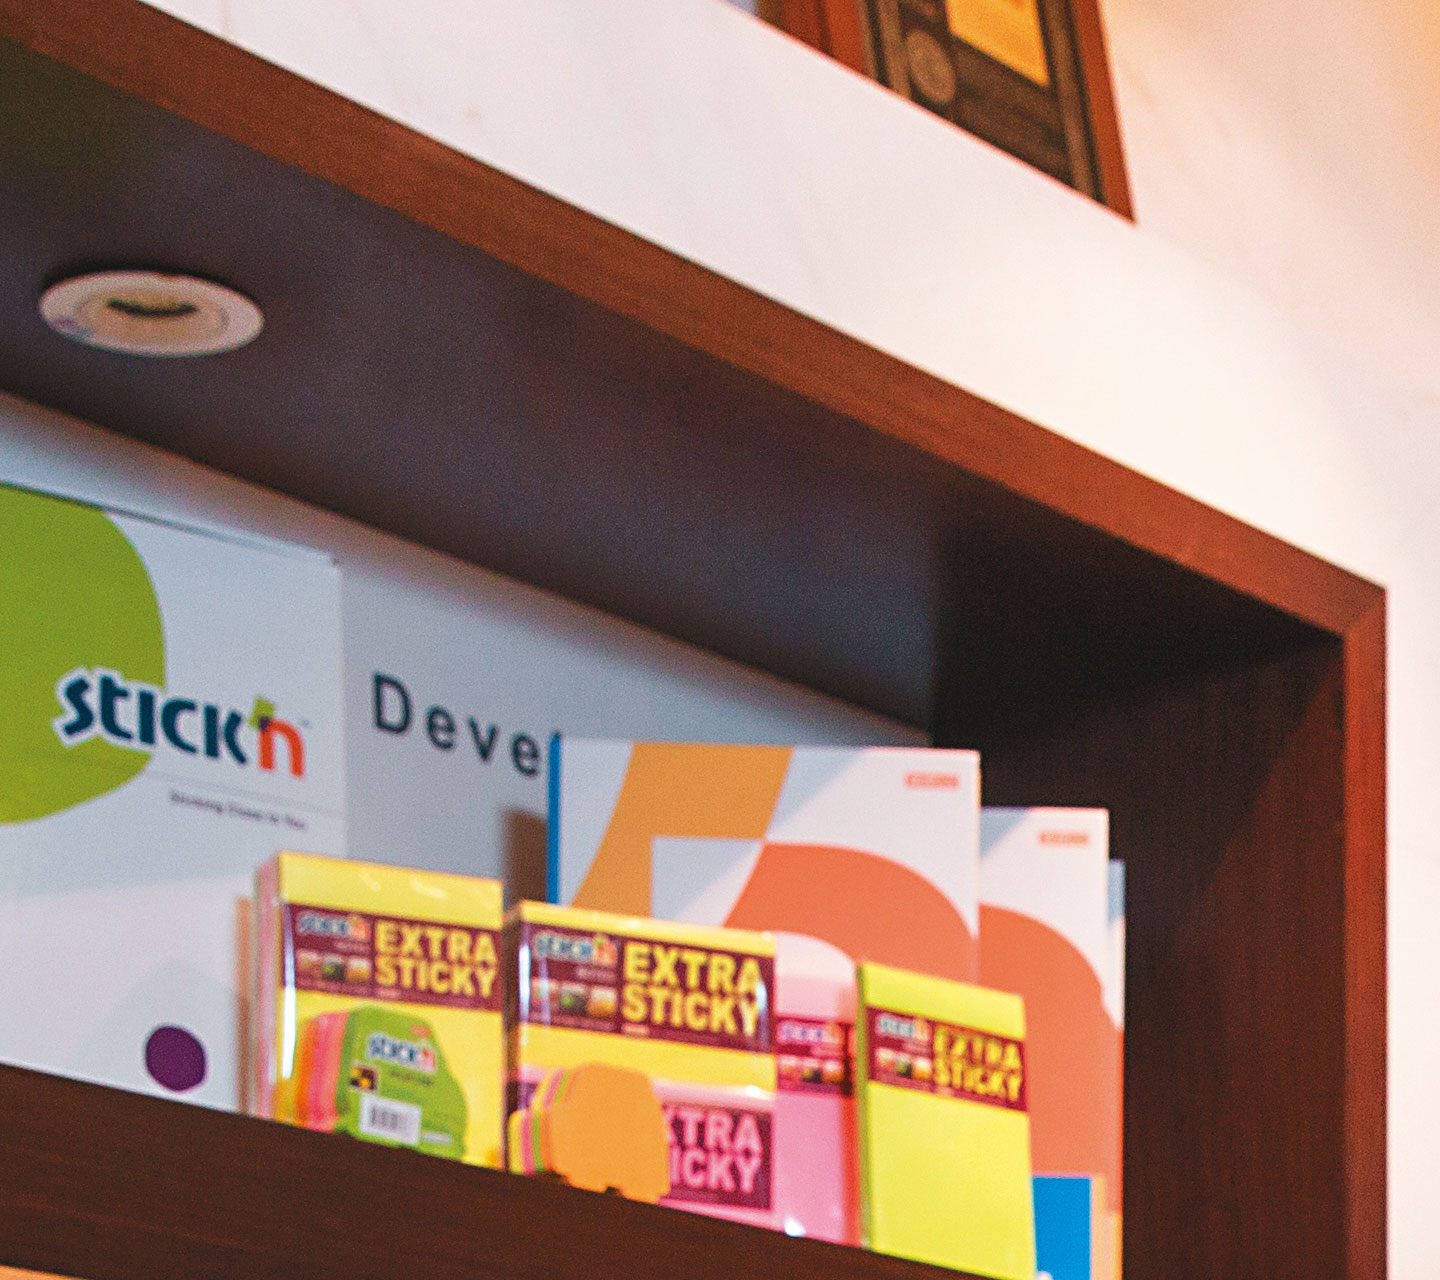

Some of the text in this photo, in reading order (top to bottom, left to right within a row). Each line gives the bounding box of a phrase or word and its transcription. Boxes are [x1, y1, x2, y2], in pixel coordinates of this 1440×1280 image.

[375, 918, 498, 964] EXTRA
[375, 954, 499, 999] STICKY
[623, 940, 762, 993] EXTRA
[622, 983, 762, 1038] STICKY
[934, 1026, 1023, 1071] EXTRA
[934, 1056, 1024, 1102] STICKY
